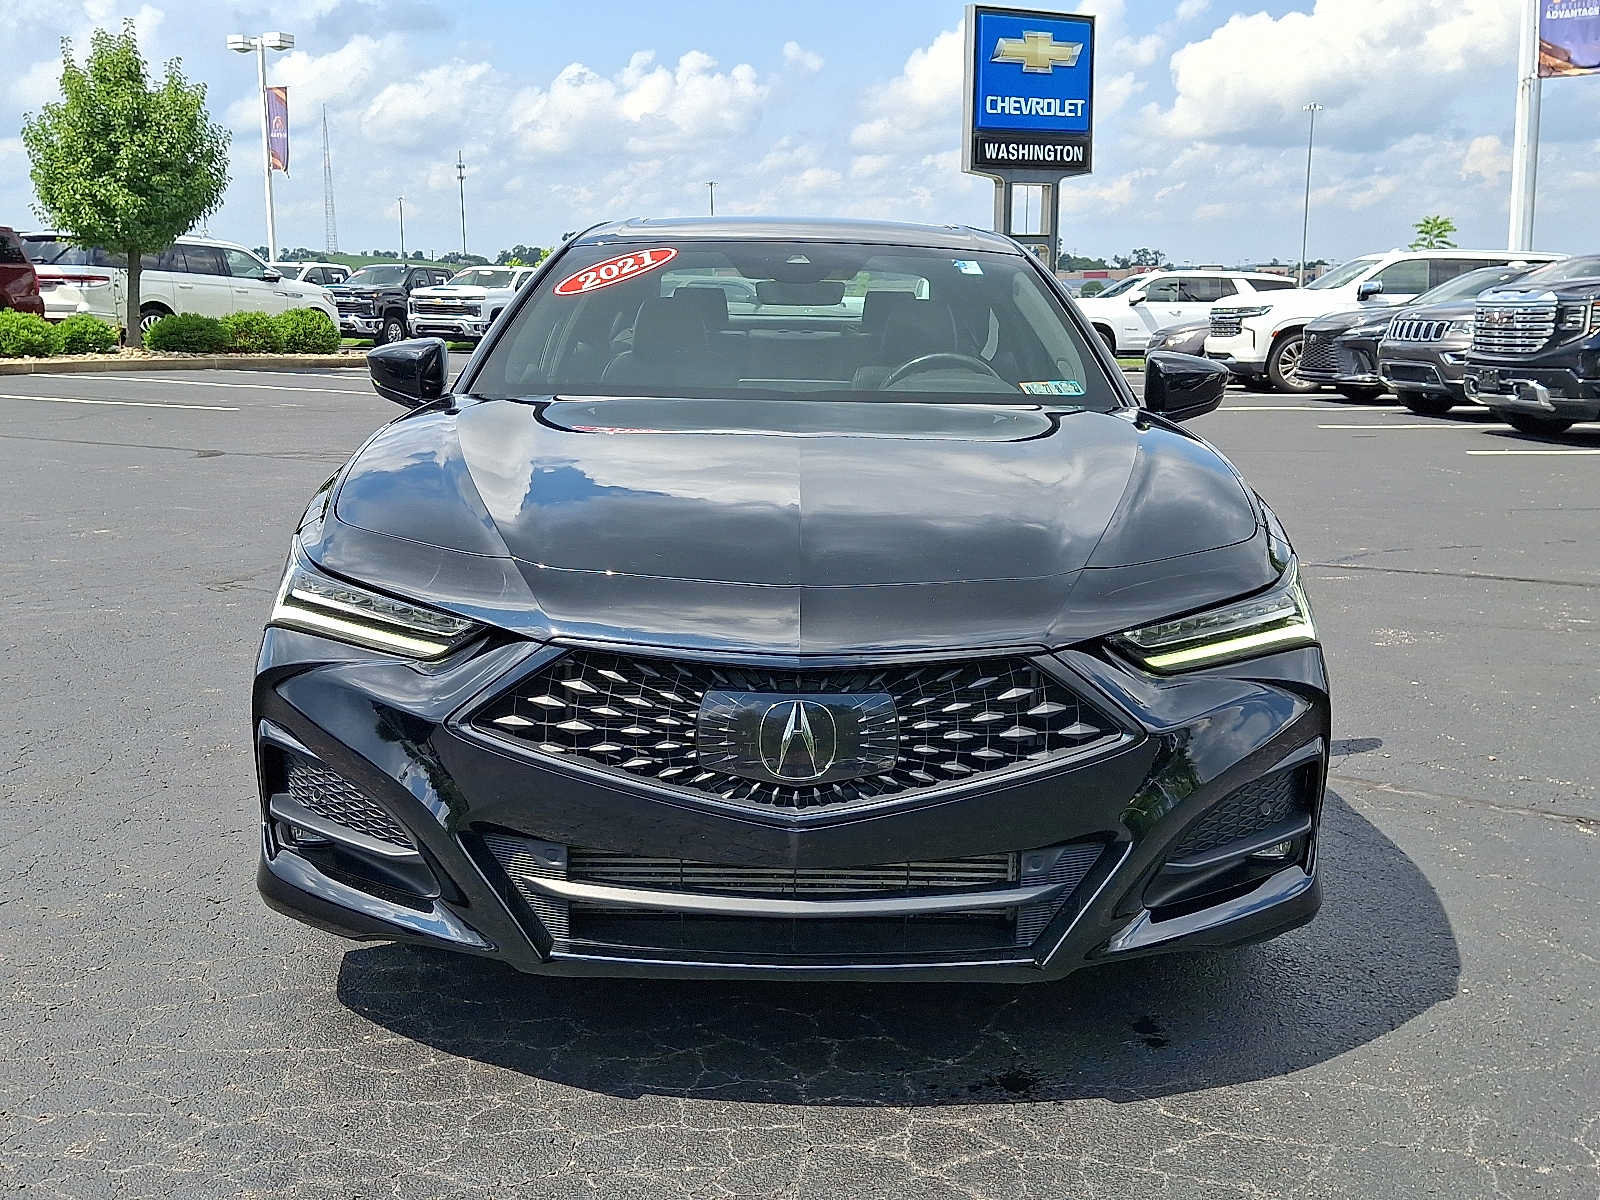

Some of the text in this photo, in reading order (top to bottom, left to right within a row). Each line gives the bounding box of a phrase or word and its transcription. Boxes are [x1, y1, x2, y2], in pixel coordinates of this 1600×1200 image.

[985, 95, 1085, 117] CHEVROLET
[984, 142, 1084, 162] WASHINGTON
[578, 250, 657, 290] 2021
